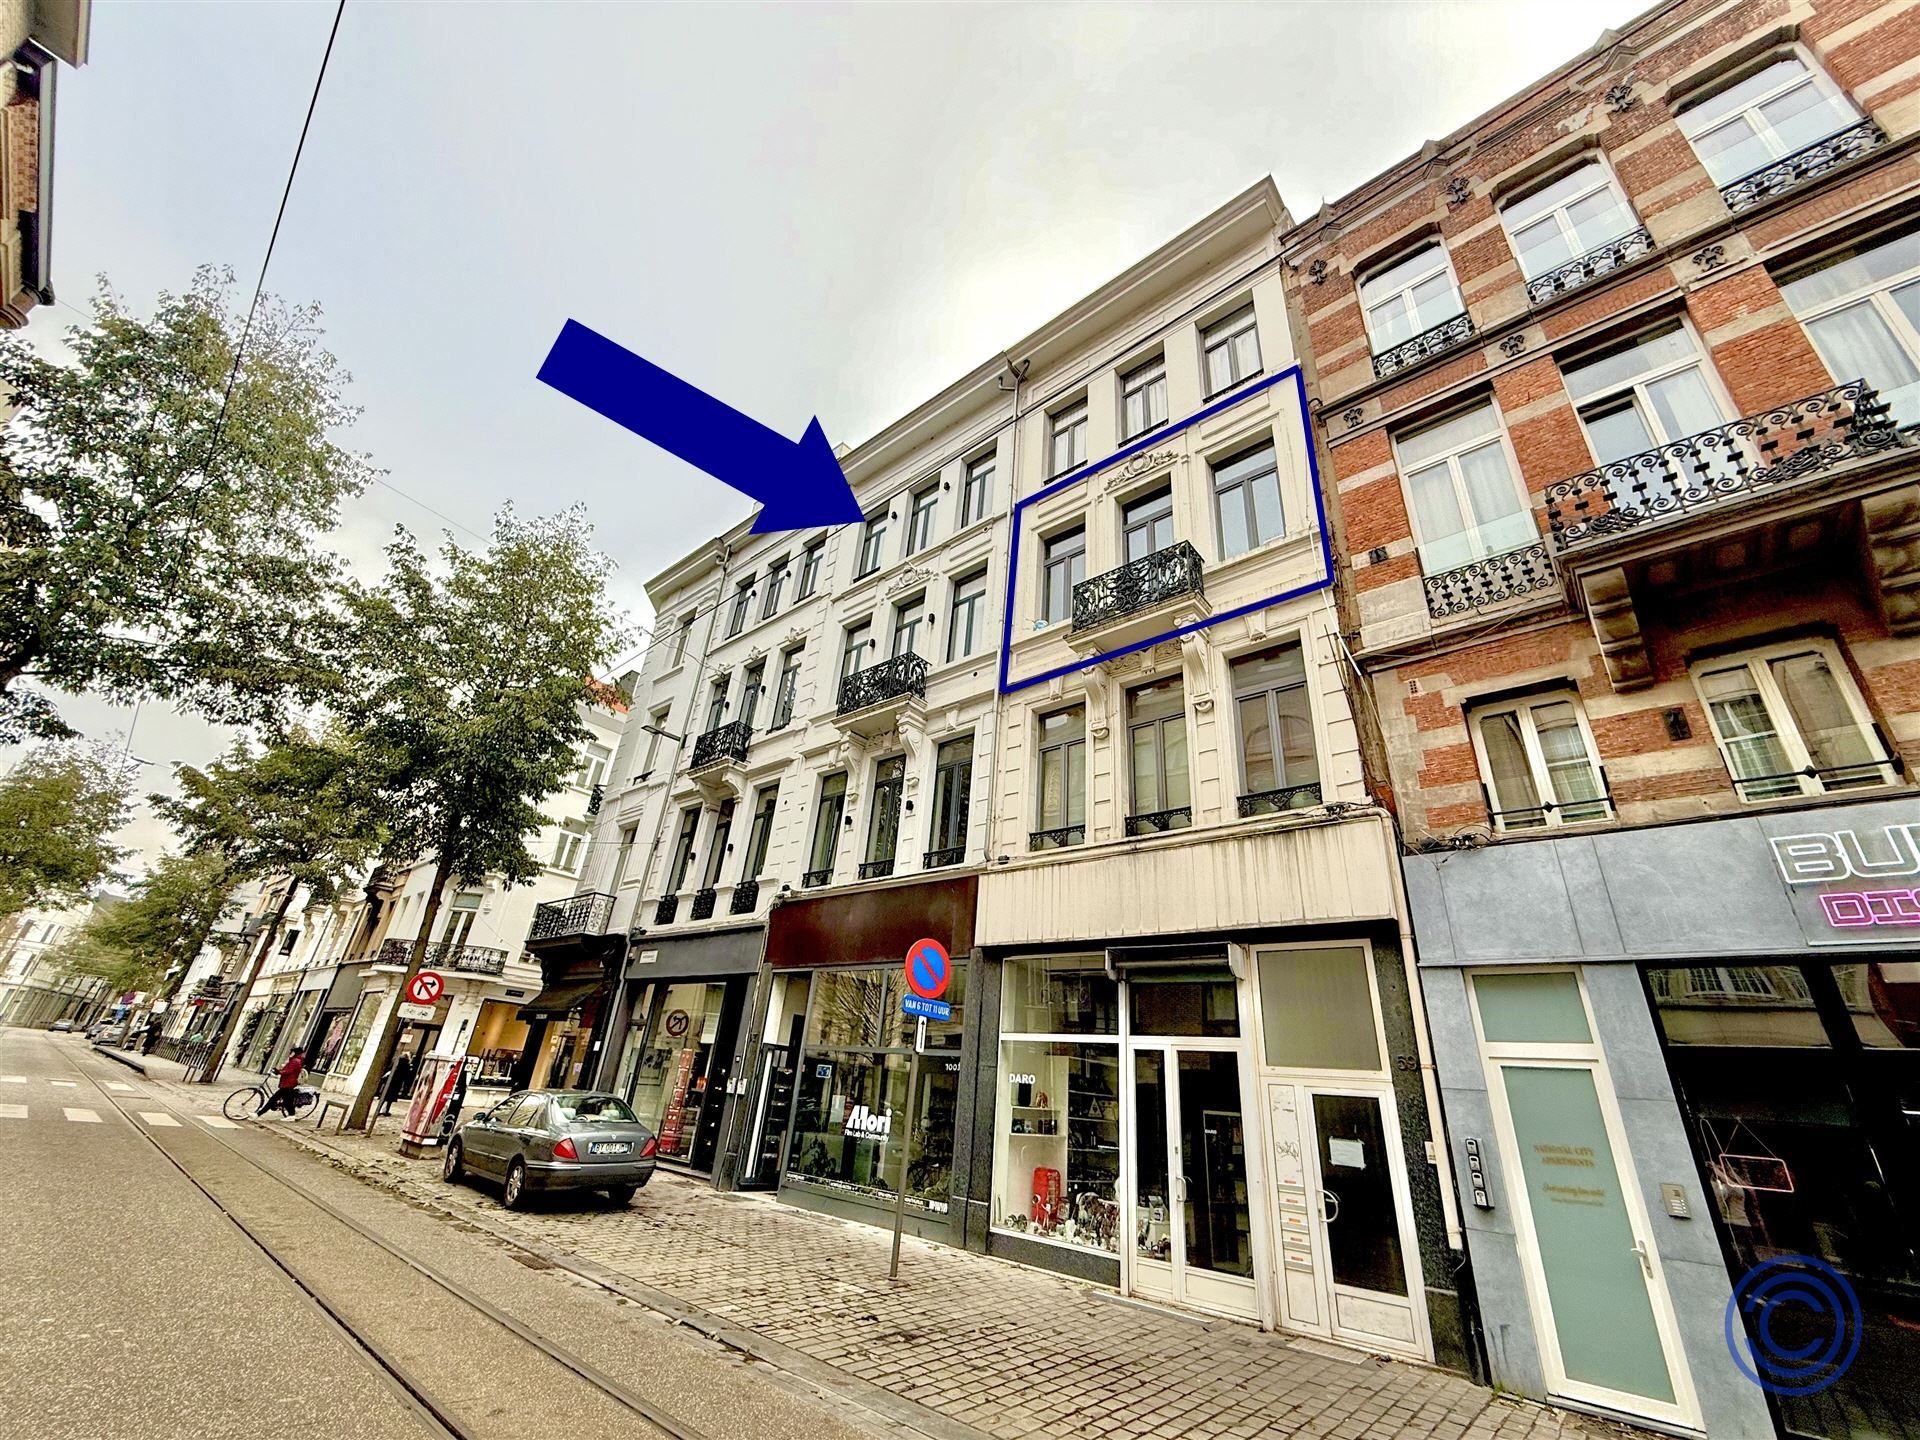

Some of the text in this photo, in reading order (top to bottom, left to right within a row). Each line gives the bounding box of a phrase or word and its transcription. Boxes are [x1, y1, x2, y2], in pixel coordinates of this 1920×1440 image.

[1769, 823, 1920, 884] BU
[1819, 888, 1920, 927] DI
[905, 999, 916, 1009] VAN
[917, 1001, 921, 1010] 6
[922, 1002, 932, 1012] TOT
[938, 1006, 950, 1016] UUR
[1009, 1073, 1036, 1084] DARO
[846, 1105, 892, 1133] Mori
